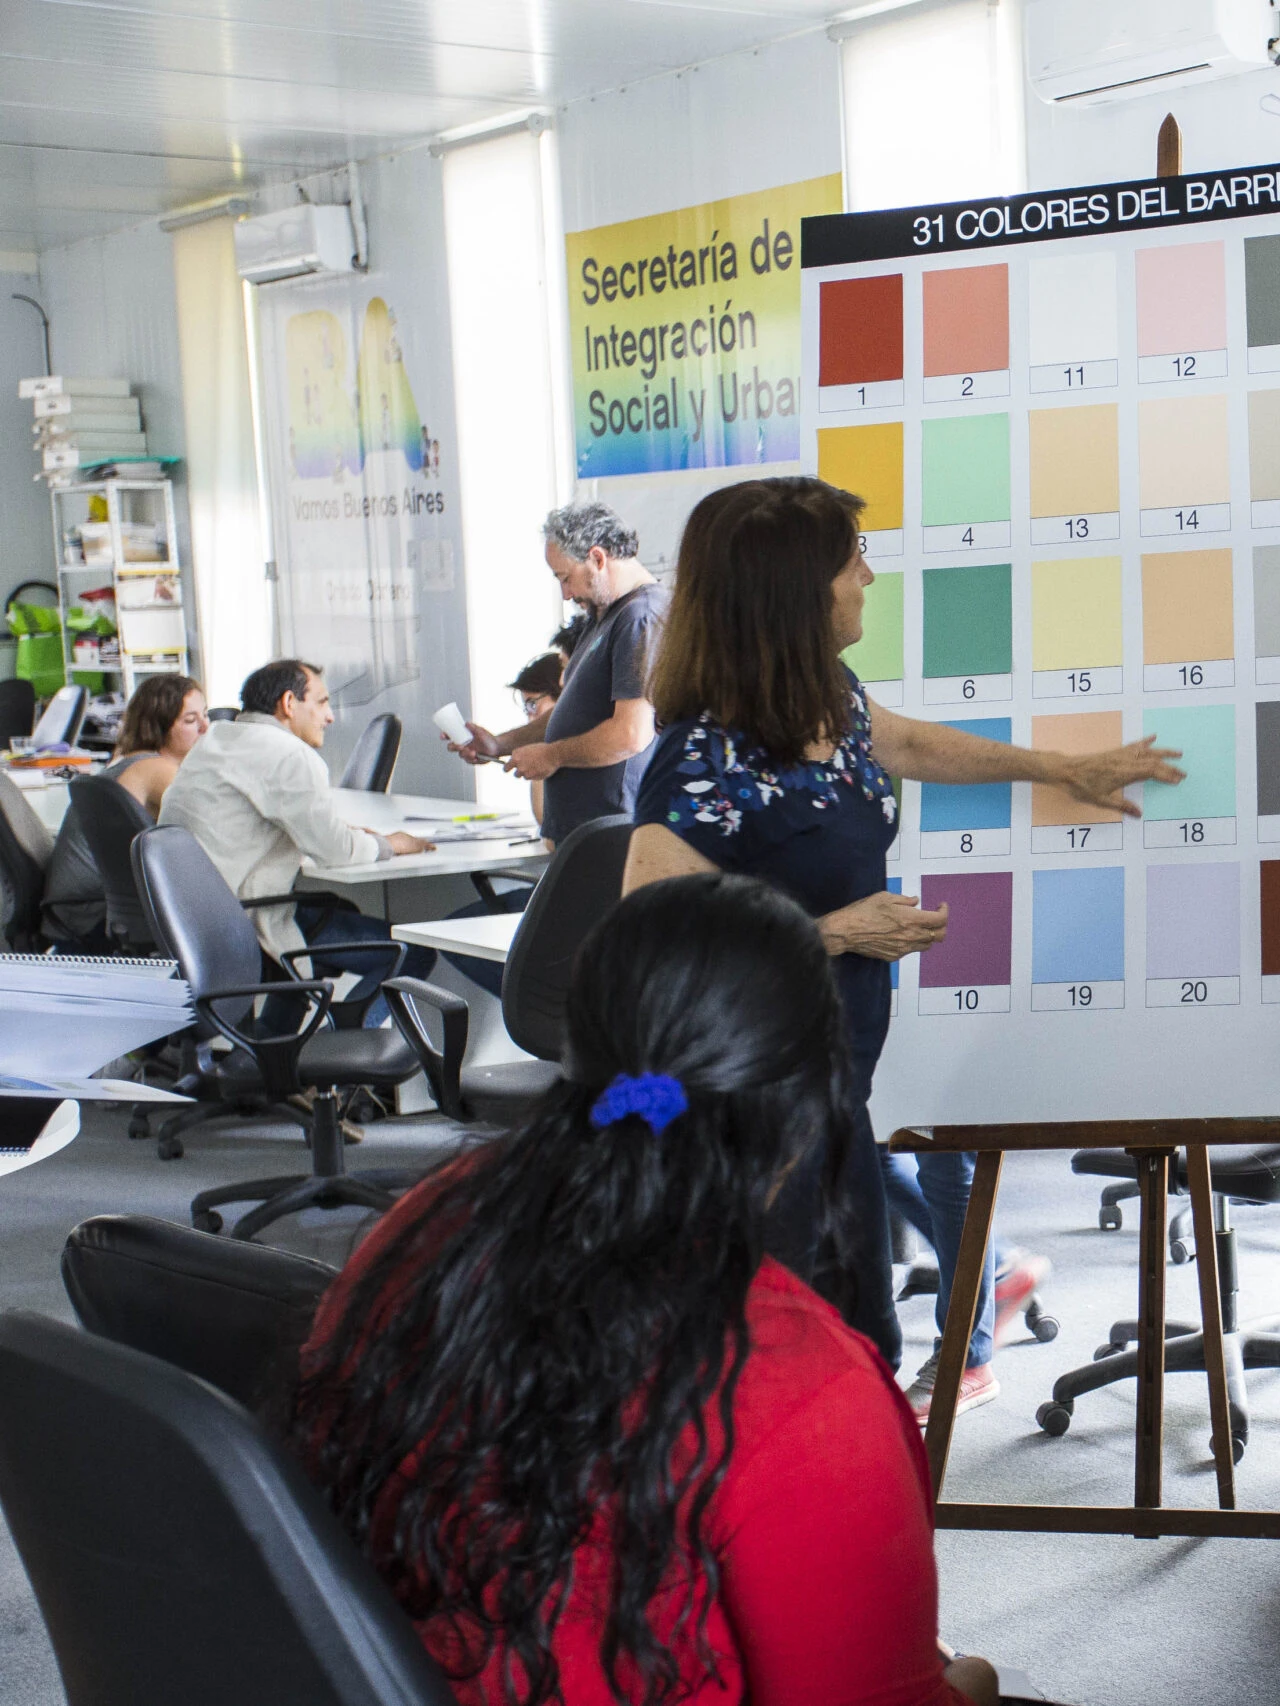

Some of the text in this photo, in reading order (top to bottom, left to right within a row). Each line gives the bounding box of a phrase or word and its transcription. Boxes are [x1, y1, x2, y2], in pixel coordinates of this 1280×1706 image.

[912, 213, 945, 246] 31
[955, 194, 1109, 241] COLORES
[1117, 183, 1180, 221] DEL
[582, 217, 793, 306] Secretaría de
[585, 299, 757, 380] Integración
[1173, 357, 1195, 376] 12
[1064, 367, 1083, 386] 11
[962, 377, 973, 396] 2
[589, 365, 800, 442] Social y Urba
[857, 387, 865, 406] 1
[292, 485, 444, 520] Vamos Buenos Aires
[1066, 519, 1088, 538] 13
[1176, 510, 1199, 530] 14
[962, 527, 974, 546] 4
[1068, 673, 1091, 692] 15
[1179, 665, 1203, 685] 16
[963, 680, 975, 699] 6
[1067, 828, 1091, 848] 17
[1180, 823, 1204, 842] 18
[961, 834, 972, 853] 8
[955, 990, 978, 1010] 10
[1068, 986, 1092, 1005] 19
[1181, 982, 1207, 1002] 20
